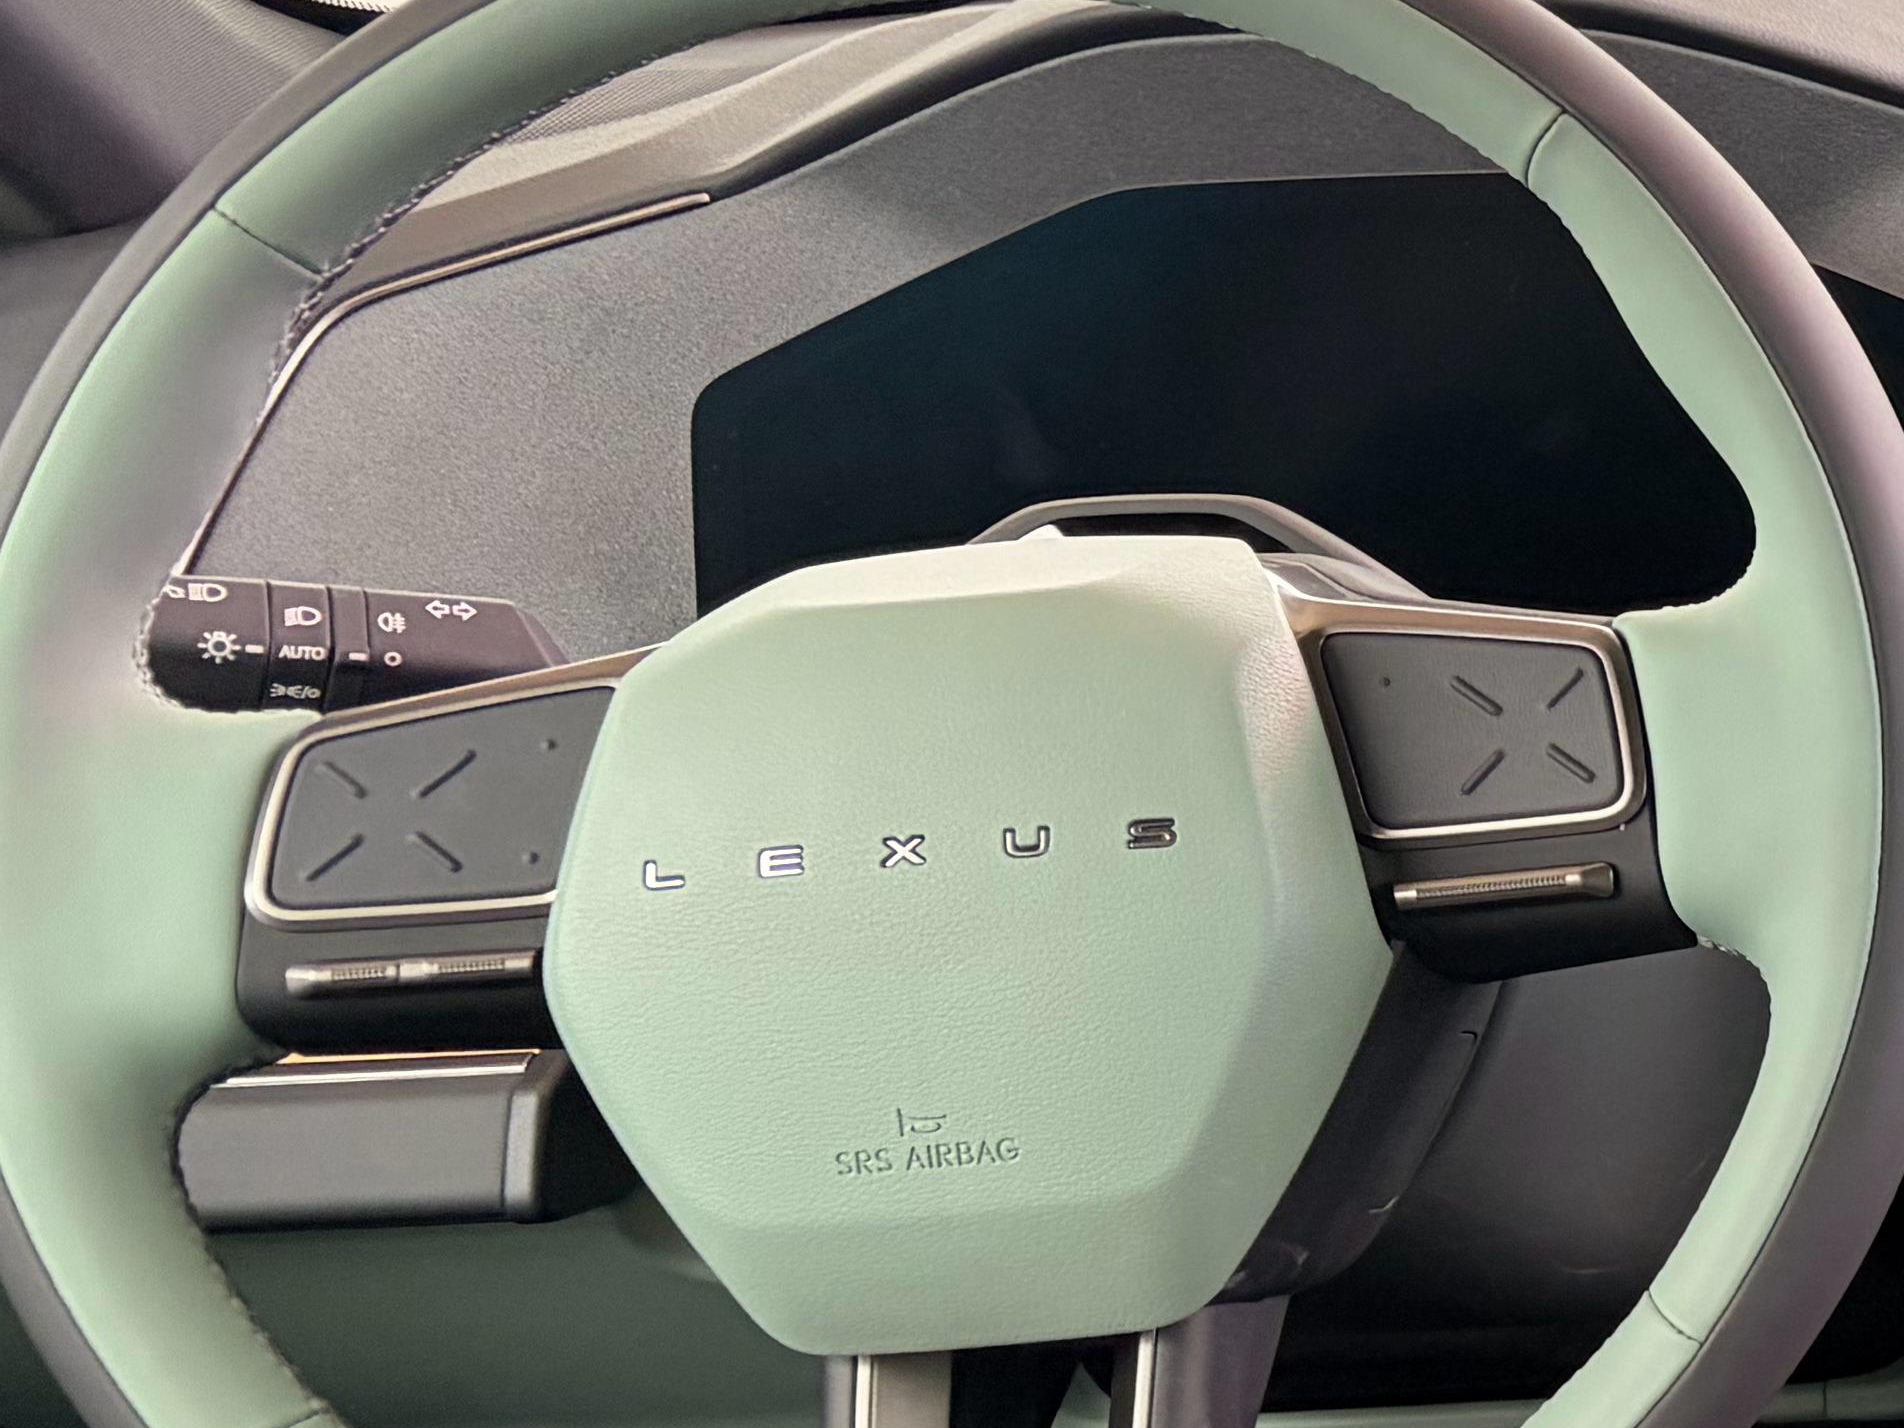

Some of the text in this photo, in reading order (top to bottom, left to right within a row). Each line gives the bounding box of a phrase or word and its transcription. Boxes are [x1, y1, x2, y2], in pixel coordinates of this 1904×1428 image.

[278, 644, 325, 661] AUTO
[643, 817, 1177, 892] LEXUS
[834, 1136, 1021, 1175] SRS AIRBAG
